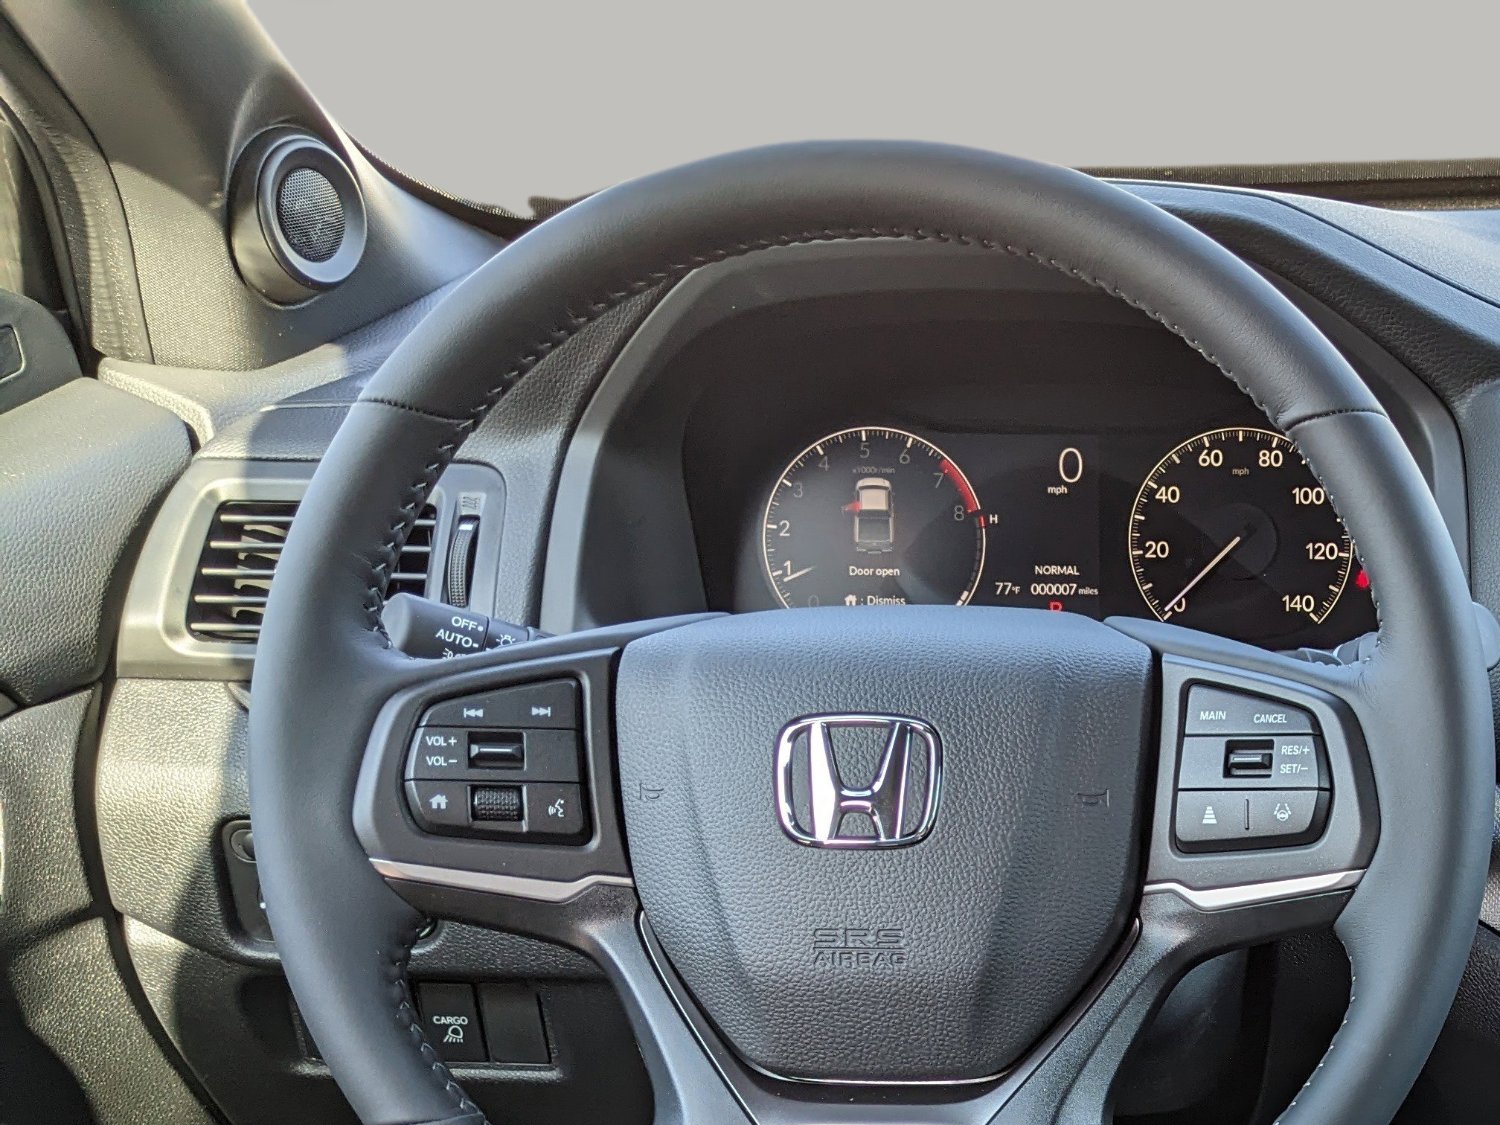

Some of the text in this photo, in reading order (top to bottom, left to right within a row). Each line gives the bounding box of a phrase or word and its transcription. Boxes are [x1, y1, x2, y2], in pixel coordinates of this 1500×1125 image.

[860, 442, 869, 458] 5
[900, 448, 910, 464] 6
[819, 456, 830, 471] 4
[1059, 447, 1083, 483] 0
[1198, 450, 1223, 467] 60
[1258, 450, 1283, 467] 80
[1232, 467, 1249, 476] mph
[933, 473, 944, 489] 7
[793, 482, 803, 498] 3
[1047, 485, 1068, 495] mph
[1155, 486, 1180, 503] 40
[1292, 487, 1325, 505] 100
[954, 505, 964, 521] 8
[990, 515, 998, 524] H
[780, 520, 790, 536] 2
[1145, 541, 1169, 558] 20
[1305, 542, 1338, 560] 120
[783, 561, 791, 575] 1
[849, 567, 900, 577] Door open
[1035, 565, 1080, 576] NORMAL
[1031, 583, 1077, 595] 000007
[1078, 586, 1098, 595] miles
[867, 596, 906, 606] Dismiss
[1282, 595, 1315, 612] 140
[451, 616, 478, 631] OFF
[1199, 711, 1227, 720] MAIN
[1253, 714, 1287, 724] CANCEL
[813, 928, 904, 947] SRS
[813, 951, 907, 966] AIRBAG
[433, 1016, 469, 1025] CARGO
